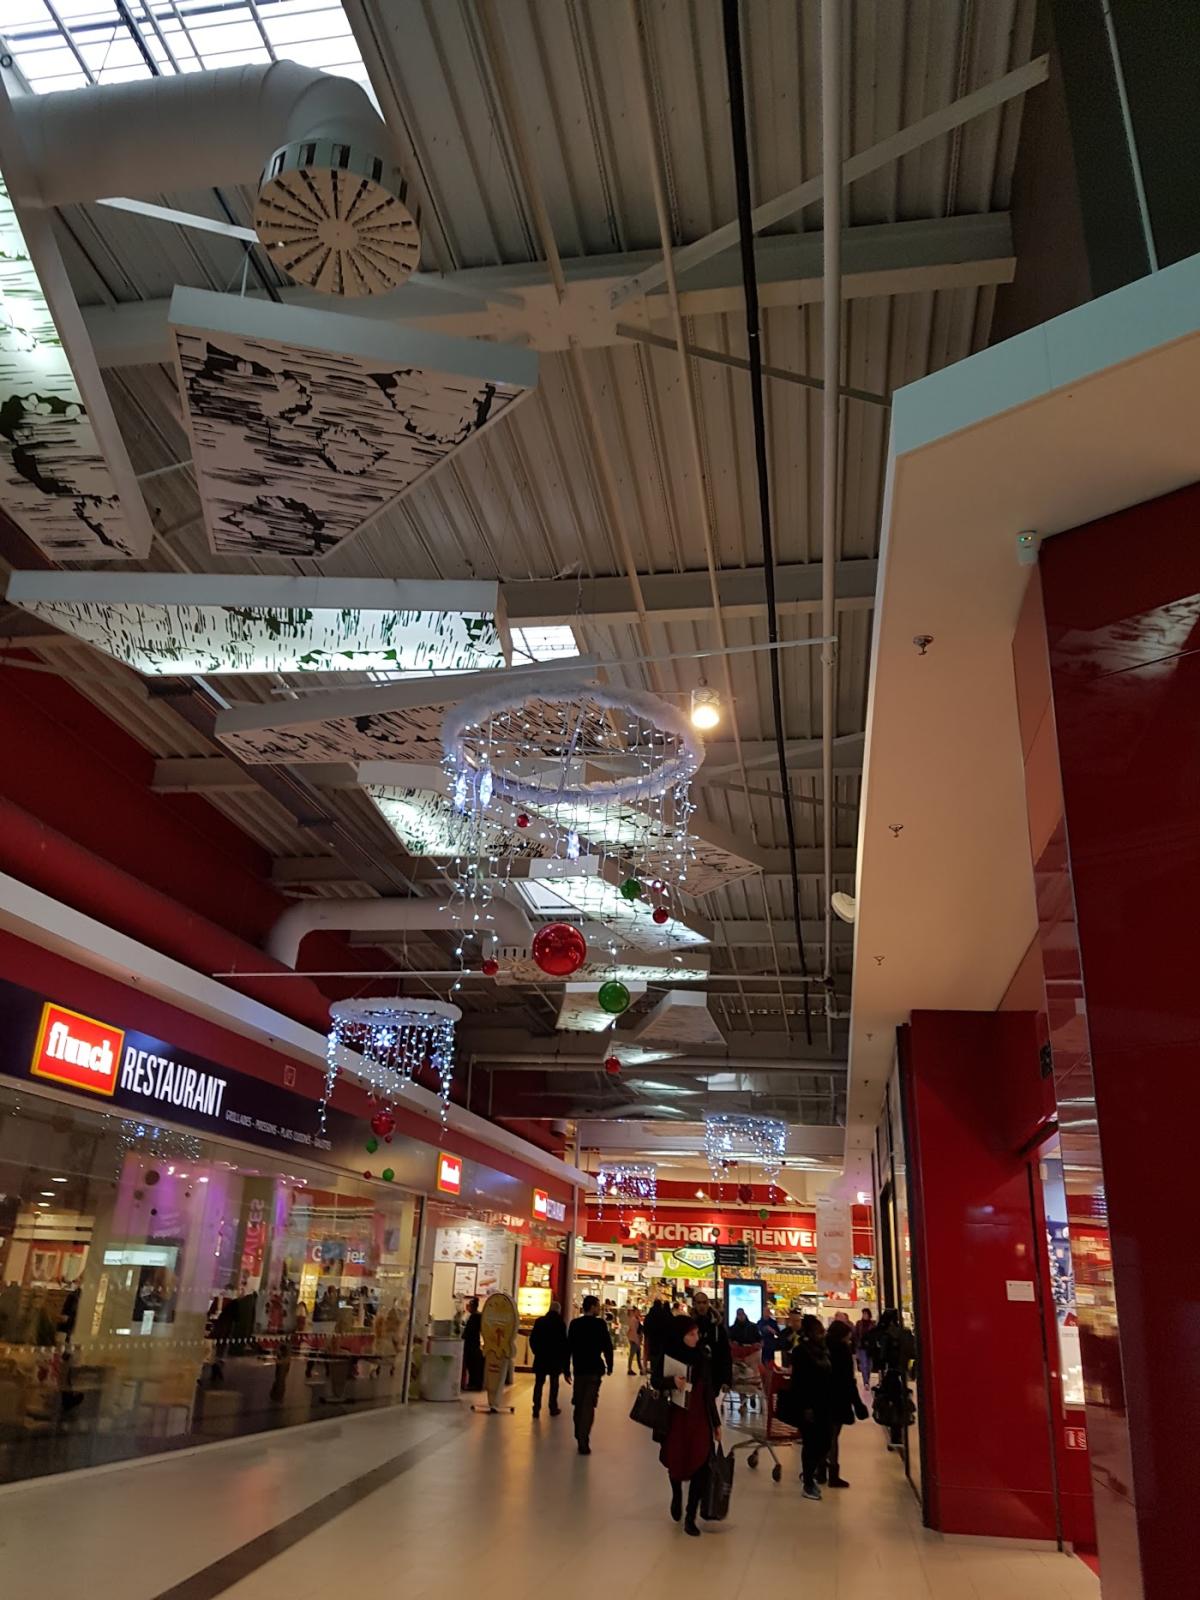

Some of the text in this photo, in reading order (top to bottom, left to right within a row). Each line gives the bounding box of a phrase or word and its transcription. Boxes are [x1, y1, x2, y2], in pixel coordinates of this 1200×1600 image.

[46, 1021, 227, 1117] flunch RESTAURANT
[629, 1217, 816, 1248] Auchan BIENVE
